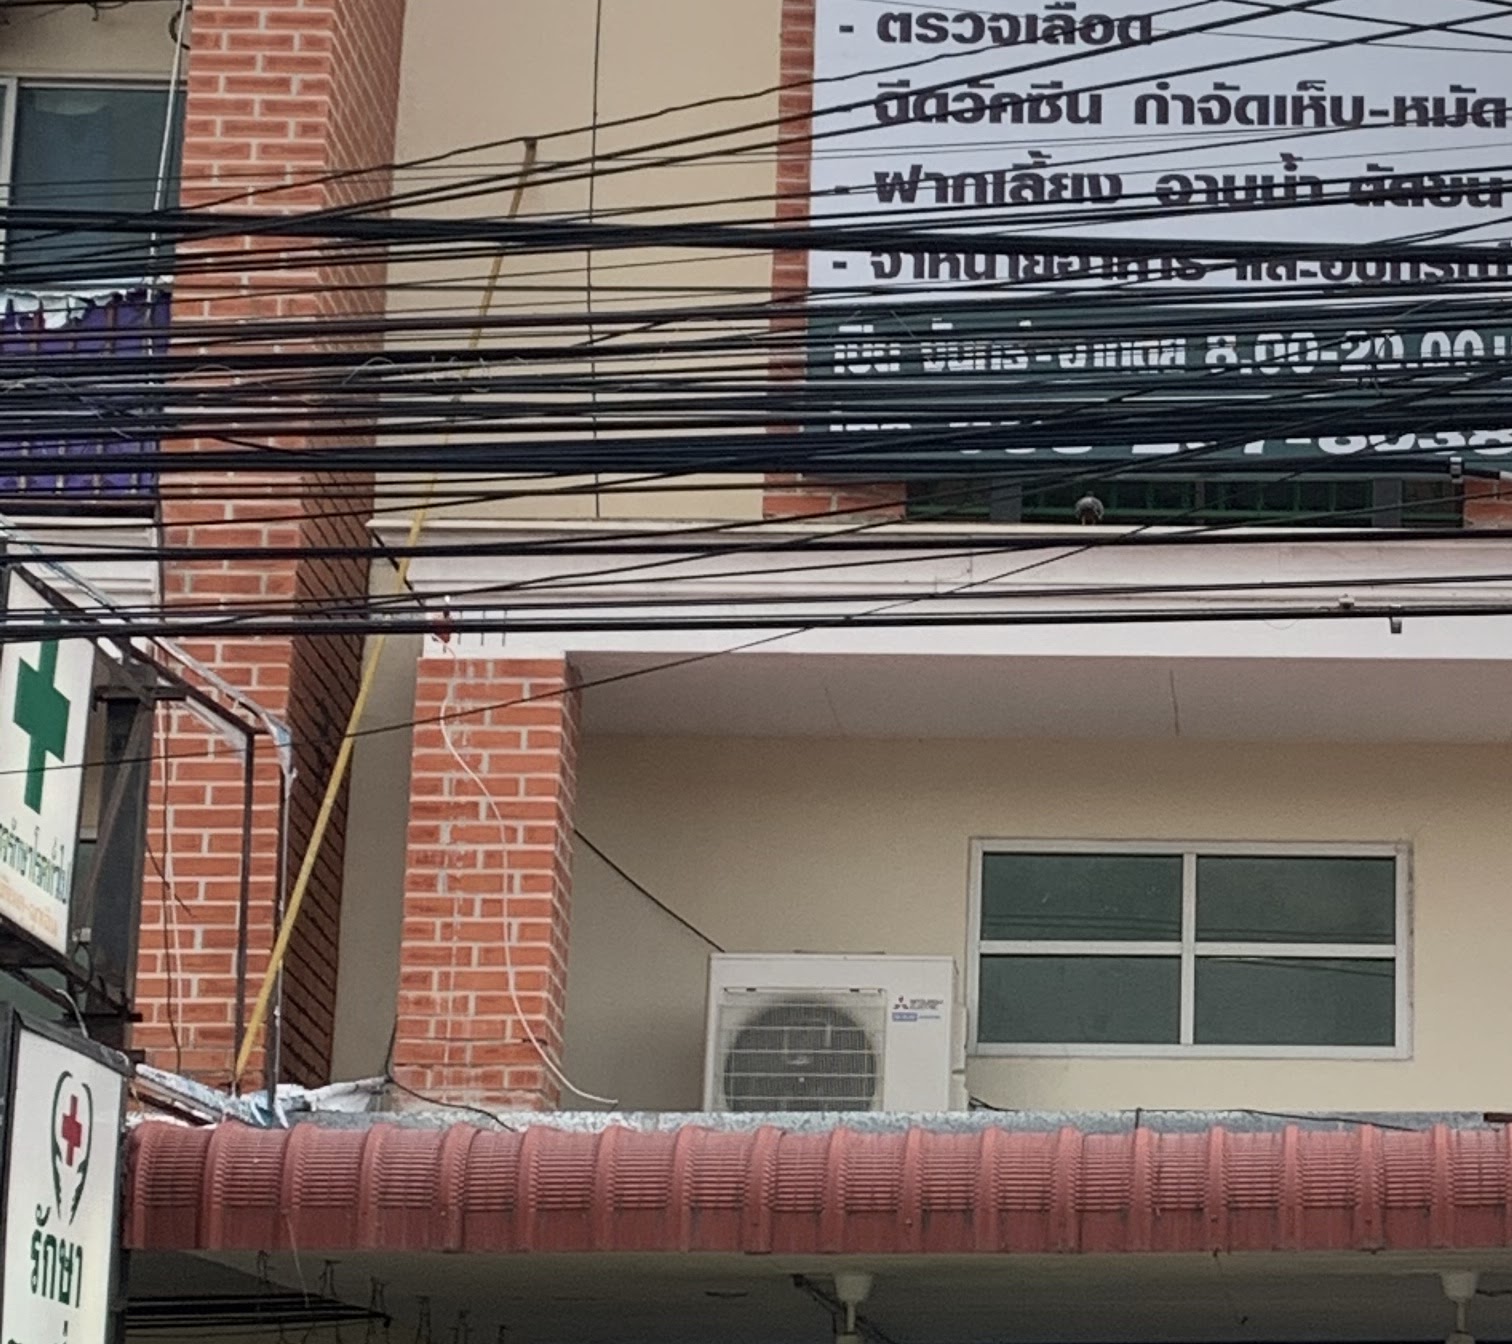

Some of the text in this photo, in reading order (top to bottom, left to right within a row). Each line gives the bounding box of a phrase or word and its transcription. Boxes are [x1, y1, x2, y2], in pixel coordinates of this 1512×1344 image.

[875, 1, 1154, 47] ตรวจเลือด
[873, 78, 1509, 129] ฉีดวัคซีน กำจัดเห็บ-หมัด
[874, 149, 1123, 208] ฝากเลี้ยง
[30, 1204, 84, 1309] รักษา
